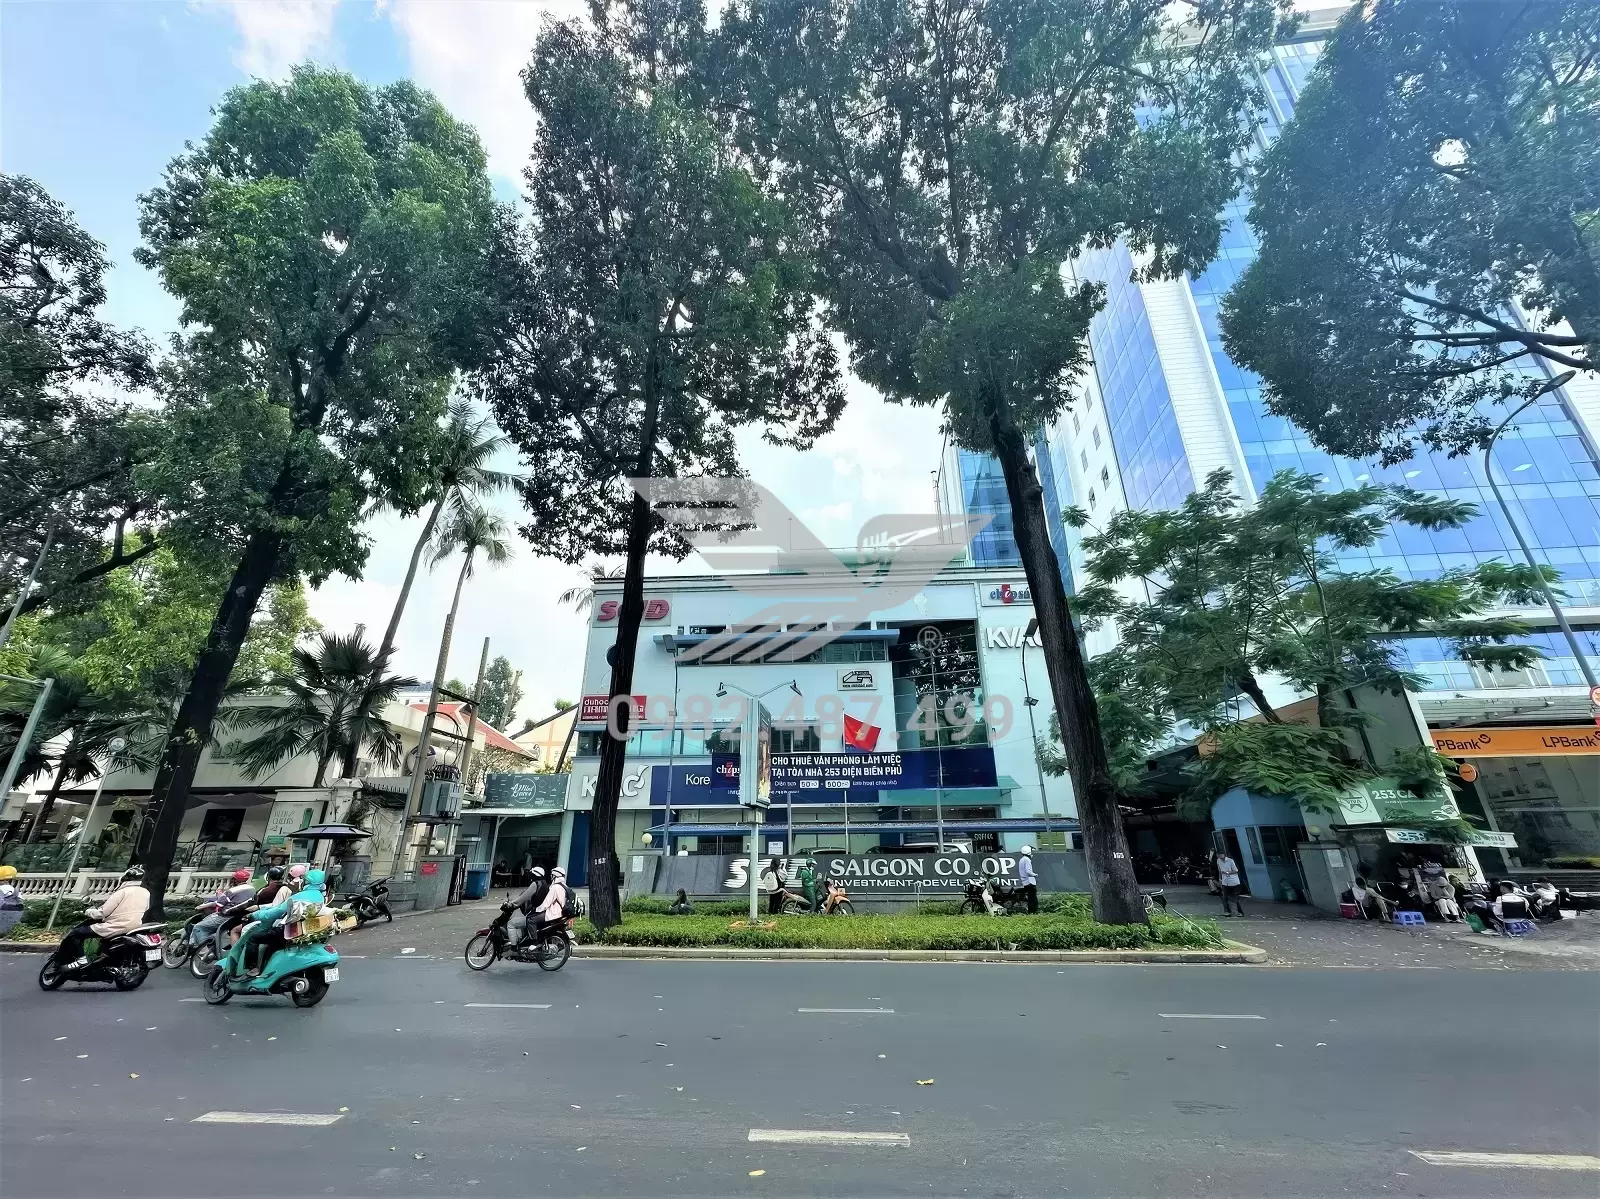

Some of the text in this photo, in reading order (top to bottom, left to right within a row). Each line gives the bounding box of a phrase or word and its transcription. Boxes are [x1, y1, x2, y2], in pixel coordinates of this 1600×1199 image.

[597, 600, 670, 620] SD
[1436, 739, 1481, 751] PBank
[1542, 735, 1597, 748] LPBank
[772, 756, 789, 766] CHO
[790, 754, 812, 766] THUÊ
[832, 754, 861, 766] PHÒNG
[862, 753, 881, 765] LÀM
[882, 754, 902, 767] VIỆC
[685, 773, 711, 785] Kore
[772, 768, 785, 779] TẠI
[787, 767, 803, 777] TÒA
[805, 766, 823, 777] NHÀ
[824, 767, 840, 777] 253
[842, 766, 862, 778] ĐIỆN
[864, 765, 883, 776] BIÊN
[581, 773, 646, 798] KC
[1372, 789, 1397, 800] 253
[829, 858, 924, 877] SAIGON
